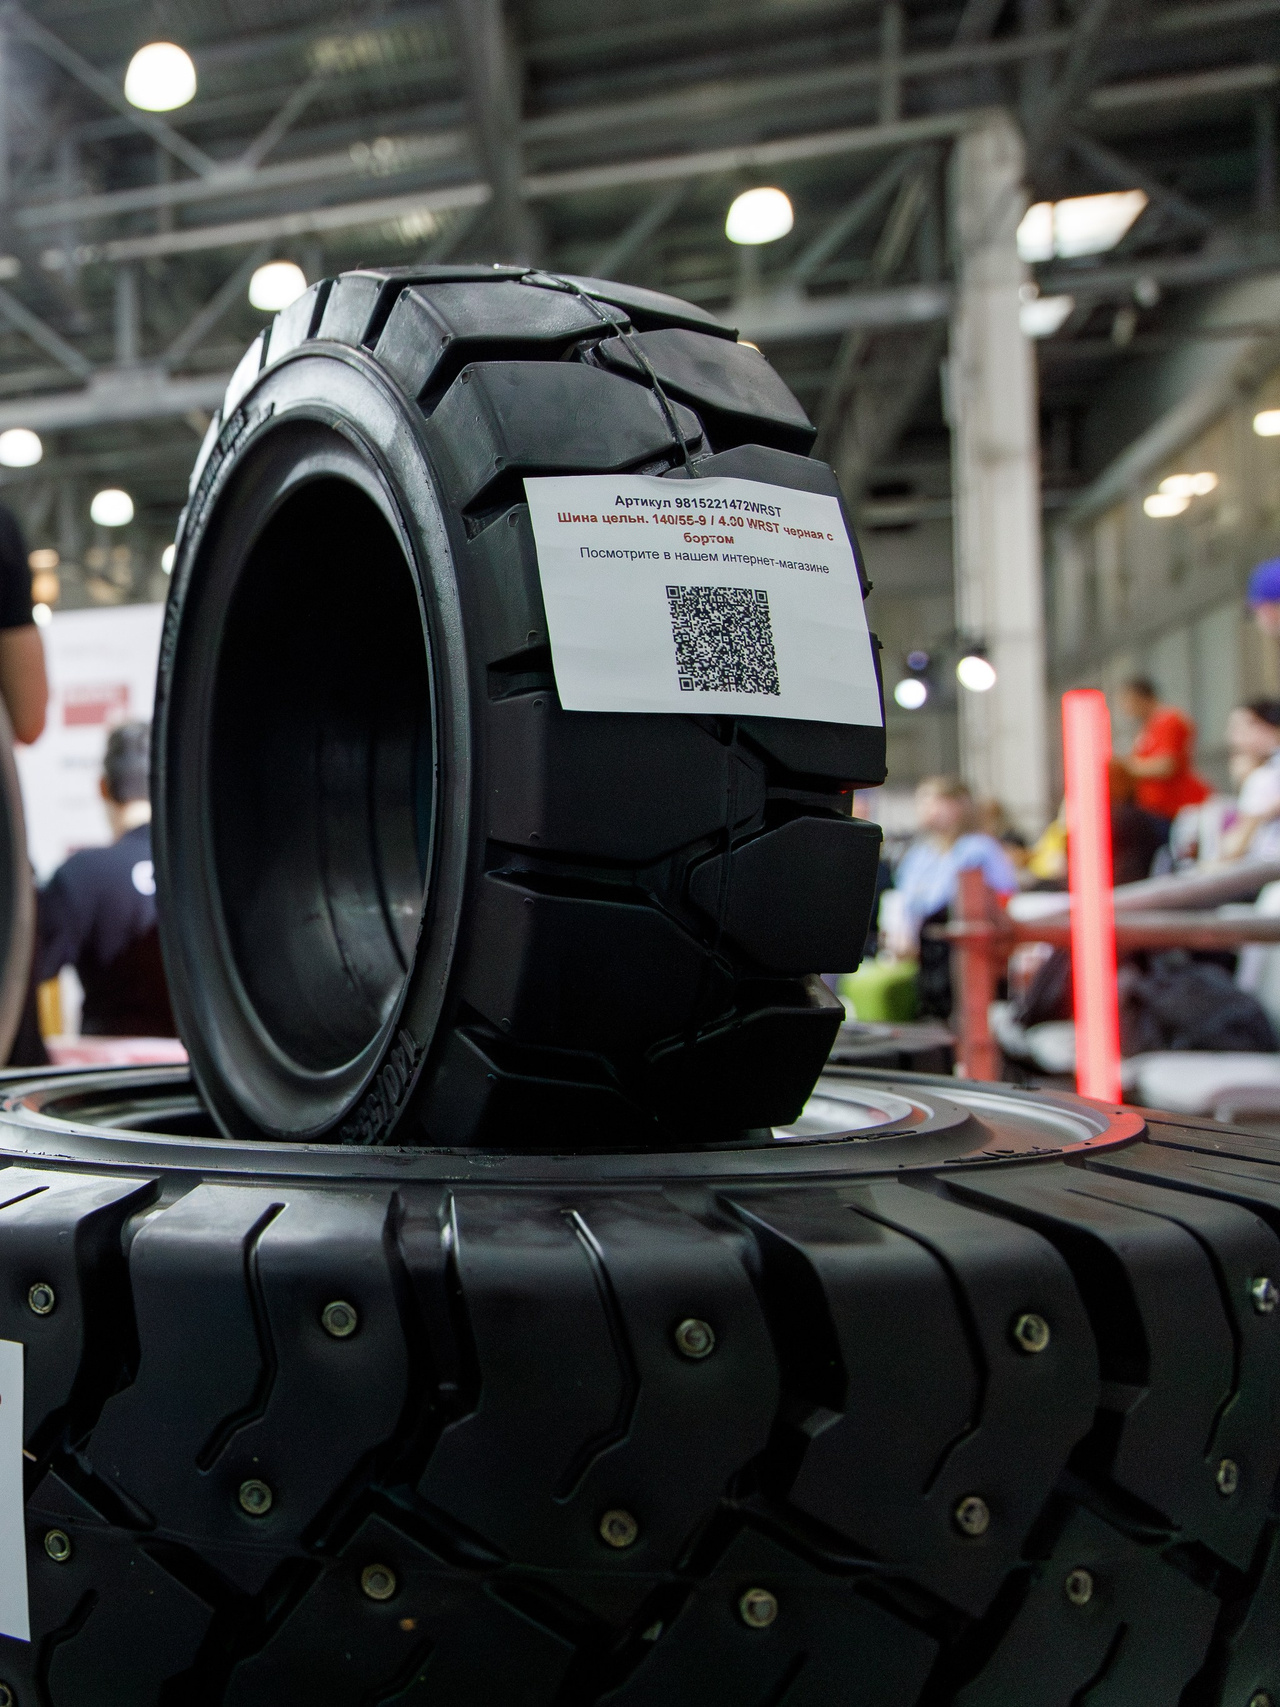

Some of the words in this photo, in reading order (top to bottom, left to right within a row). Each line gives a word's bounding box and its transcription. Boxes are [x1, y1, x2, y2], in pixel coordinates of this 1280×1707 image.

[615, 495, 672, 510] Артикул
[675, 497, 782, 518] 9815221472WRST
[557, 512, 598, 523] Шина
[602, 514, 649, 525] цельн.
[652, 513, 707, 526] 140/55-9
[718, 515, 744, 528] 4.00
[746, 517, 780, 534] WRST
[783, 526, 824, 540] черная
[683, 532, 735, 546] бортом
[579, 546, 660, 561] Посмотрите
[664, 551, 672, 560] в
[675, 551, 719, 562] нашем
[722, 552, 830, 574] интернет-магазине
